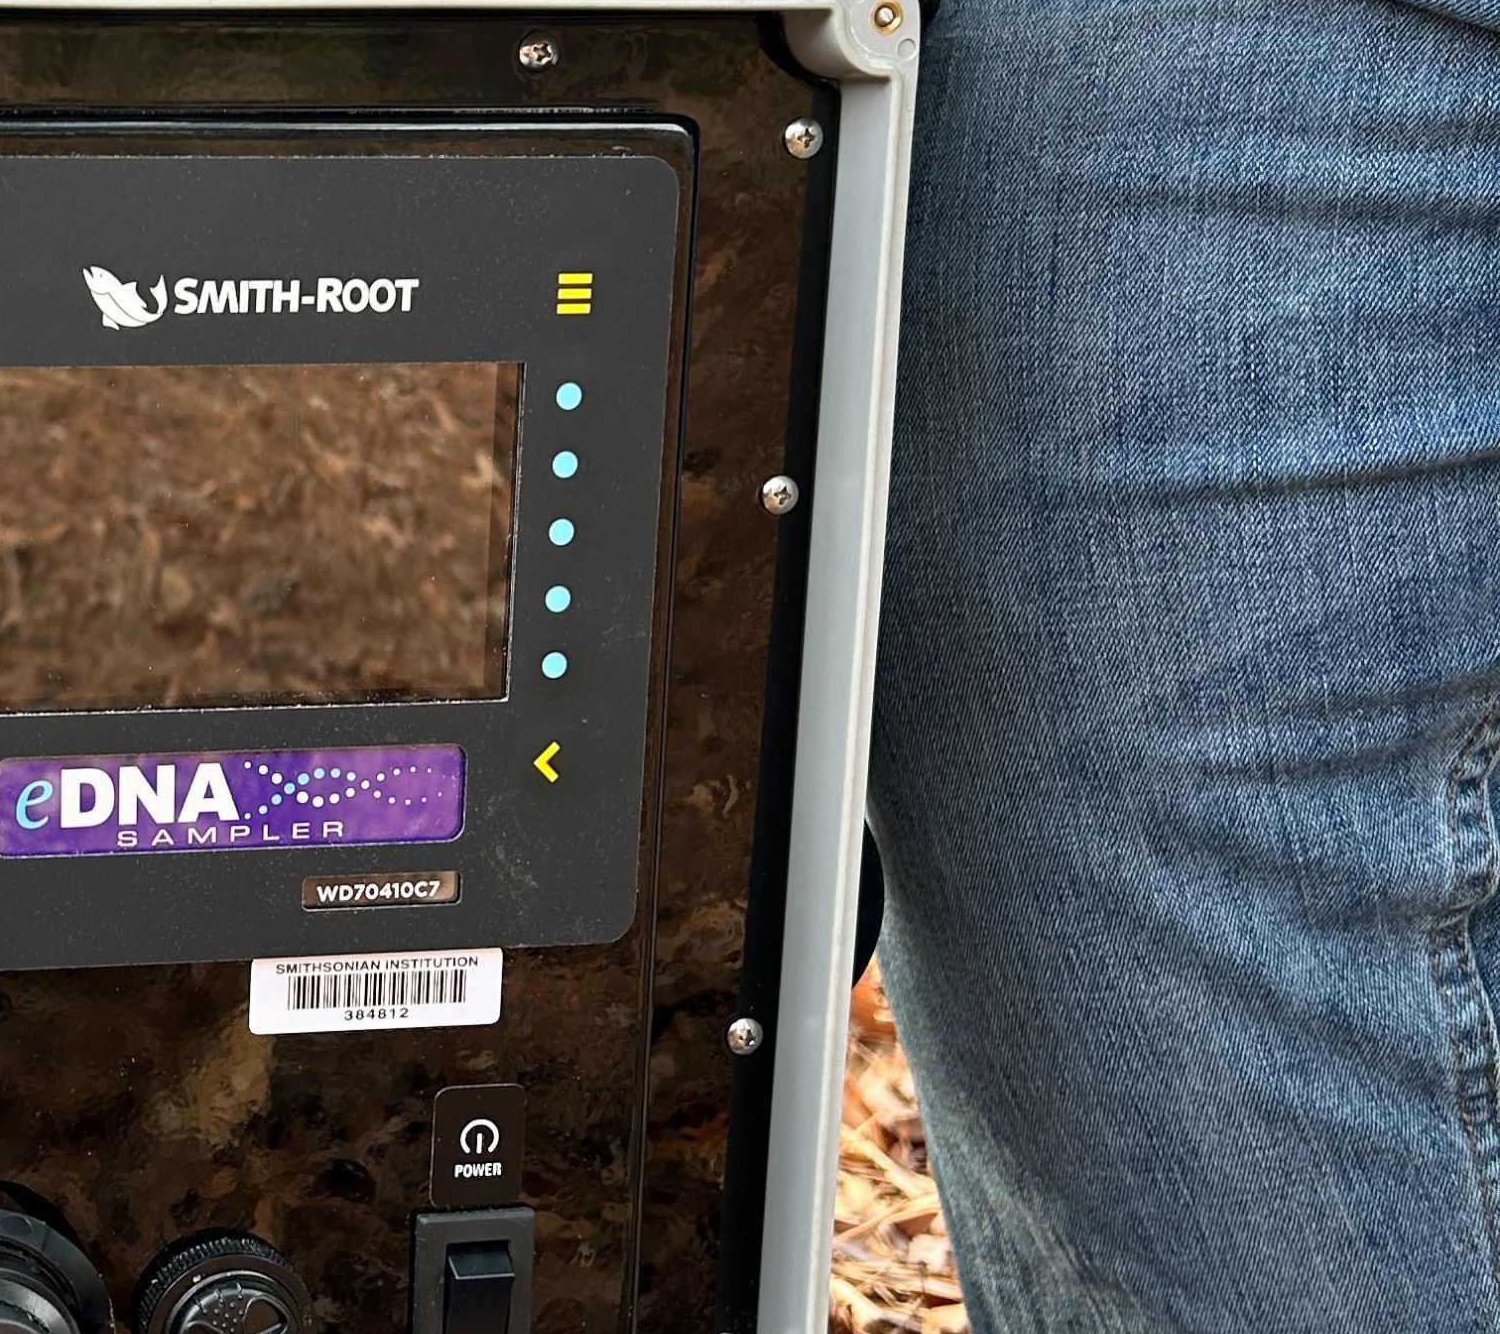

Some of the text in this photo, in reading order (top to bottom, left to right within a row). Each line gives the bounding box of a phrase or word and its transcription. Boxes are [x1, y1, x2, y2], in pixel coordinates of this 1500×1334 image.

[173, 277, 420, 315] SMITH-ROOT
[15, 762, 240, 830] eDNA
[117, 820, 345, 848] SAMPLER
[316, 880, 441, 903] WD70410C7
[275, 956, 479, 975] SMITHSONIAN INSTITUTION
[343, 1007, 409, 1021] 384812
[454, 1162, 502, 1179] POWER
